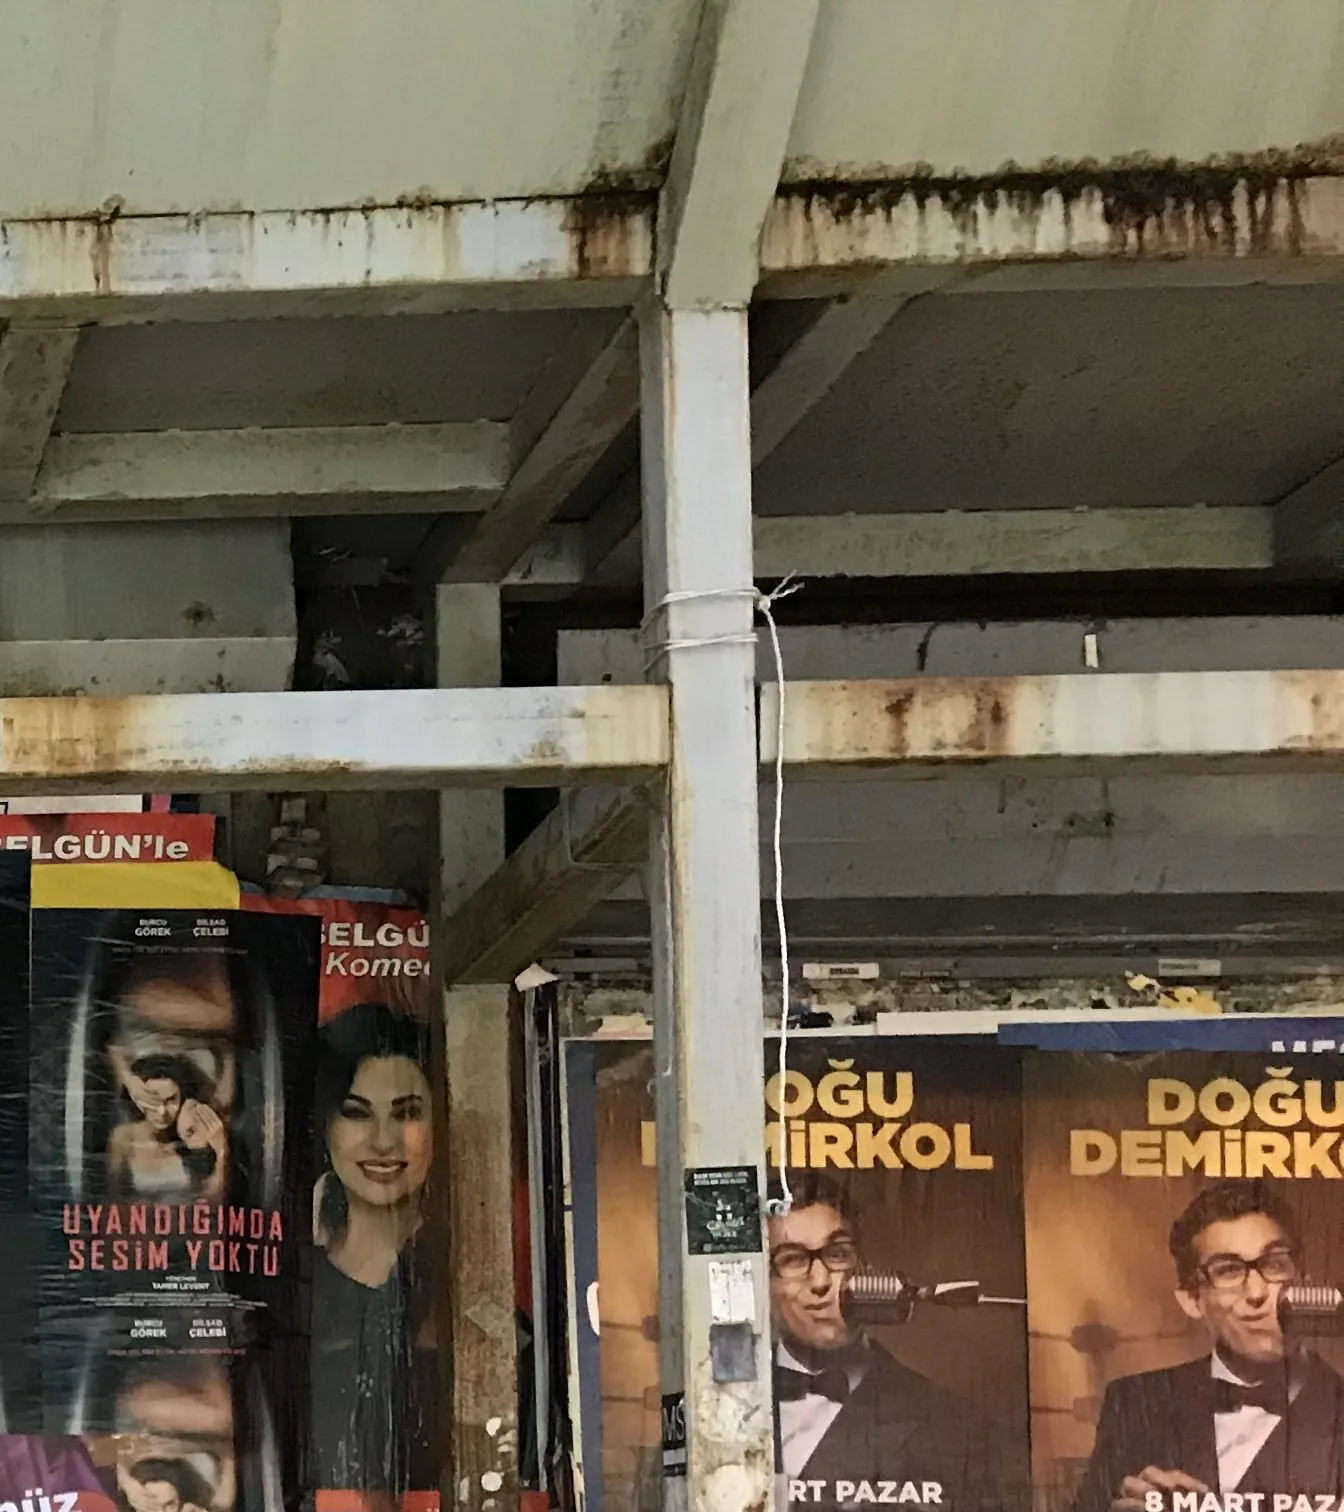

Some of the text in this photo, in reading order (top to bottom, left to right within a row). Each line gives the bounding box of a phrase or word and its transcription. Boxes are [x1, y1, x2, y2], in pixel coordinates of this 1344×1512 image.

[321, 919, 429, 947] ELGÜ
[765, 1058, 914, 1118] OĞU
[1148, 1066, 1344, 1127] DOĞU
[1070, 1129, 1344, 1178] DEMİRK
[63, 1198, 283, 1241] UYANDIĞIMDA
[186, 1240, 279, 1276] YOKTU
[789, 1480, 943, 1504] RT PAZAR
